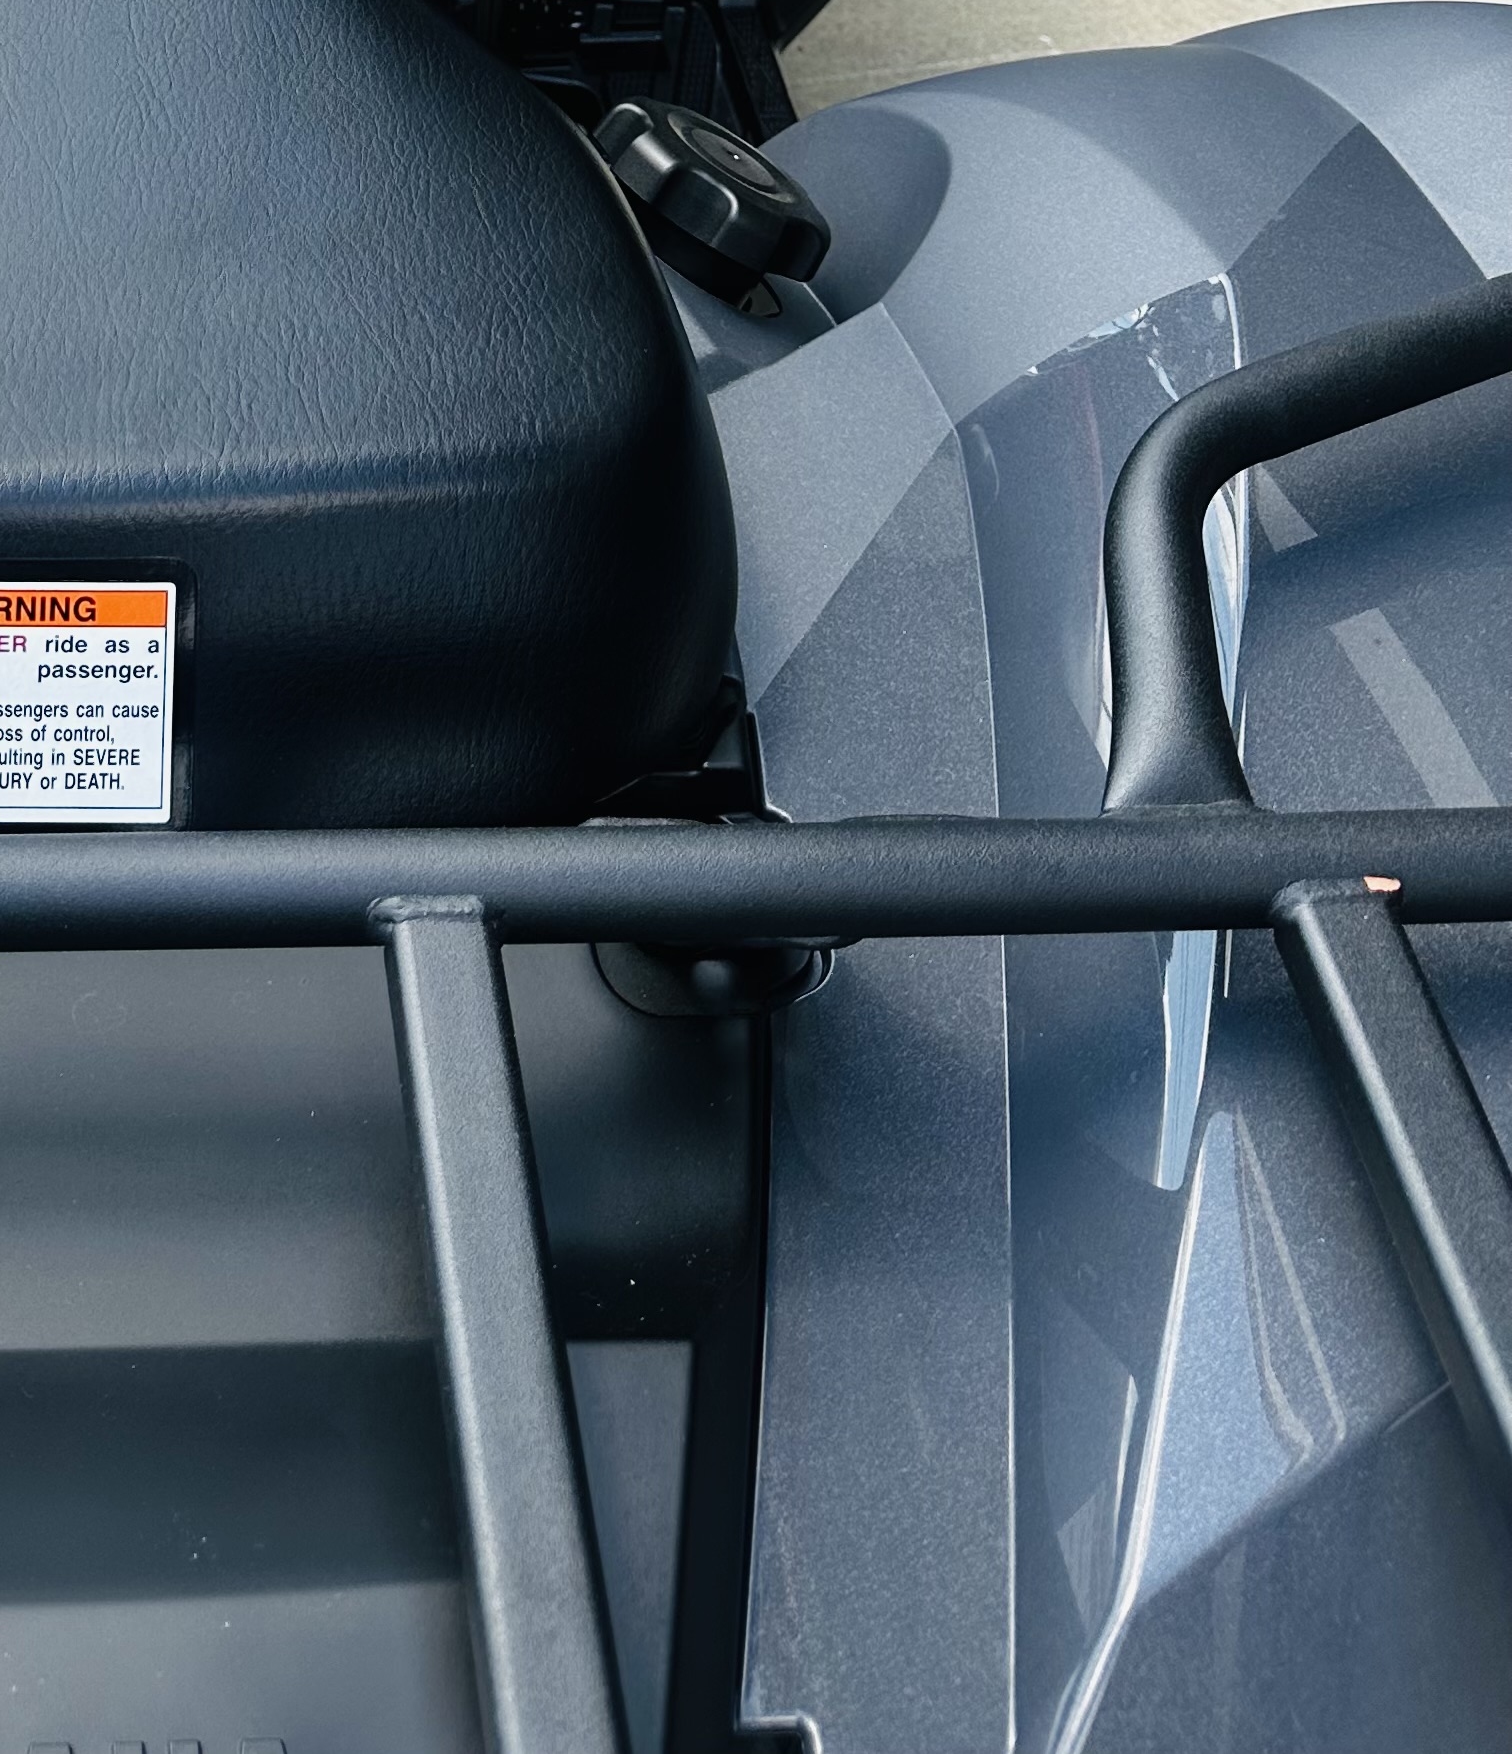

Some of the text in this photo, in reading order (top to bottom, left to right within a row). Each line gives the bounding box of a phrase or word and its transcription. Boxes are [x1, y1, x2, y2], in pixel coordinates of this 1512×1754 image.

[45, 635, 87, 653] ride
[105, 638, 130, 653] as
[148, 639, 160, 653] a
[38, 664, 159, 683] passenger.
[76, 704, 104, 718] can
[112, 704, 159, 718] cause
[30, 725, 47, 741] of
[54, 725, 115, 744] control,
[51, 748, 65, 765] in
[73, 749, 140, 766] SEVERE
[41, 776, 57, 790] or
[65, 773, 124, 790] DEATH.
